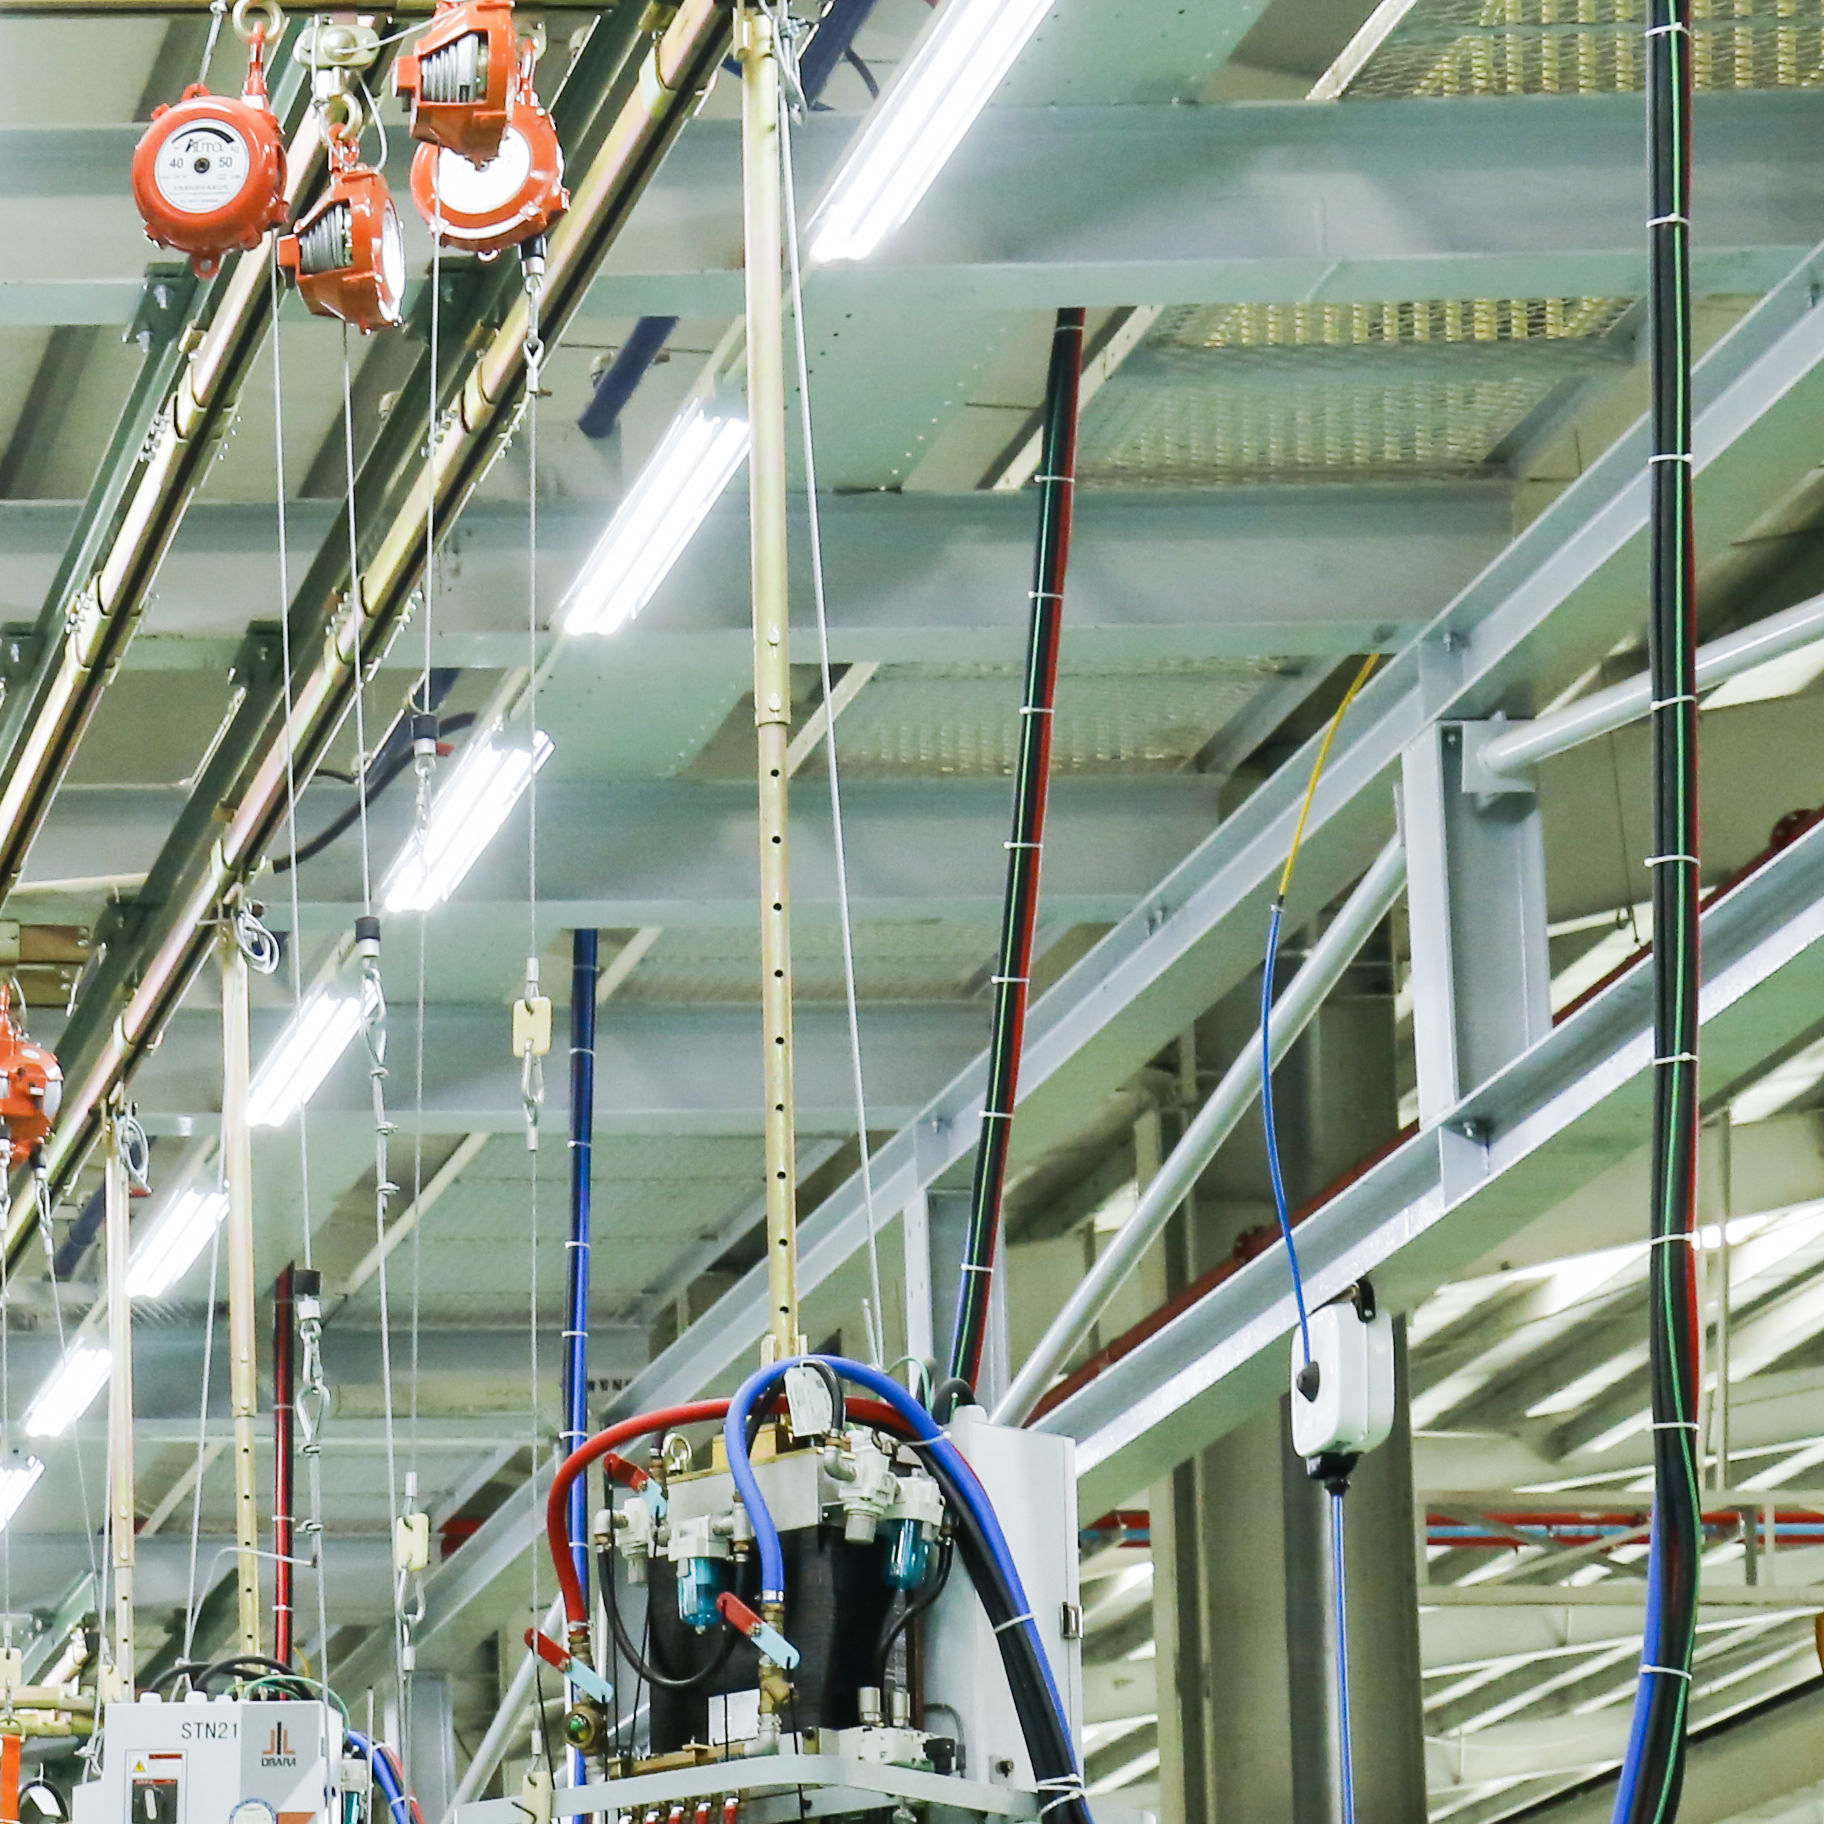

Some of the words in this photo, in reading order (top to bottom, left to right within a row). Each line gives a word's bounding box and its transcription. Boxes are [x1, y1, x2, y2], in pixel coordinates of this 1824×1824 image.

[169, 157, 184, 168] 40
[218, 156, 233, 168] 50
[181, 1722, 238, 1740] STN21
[261, 1758, 297, 1767] OBARA
